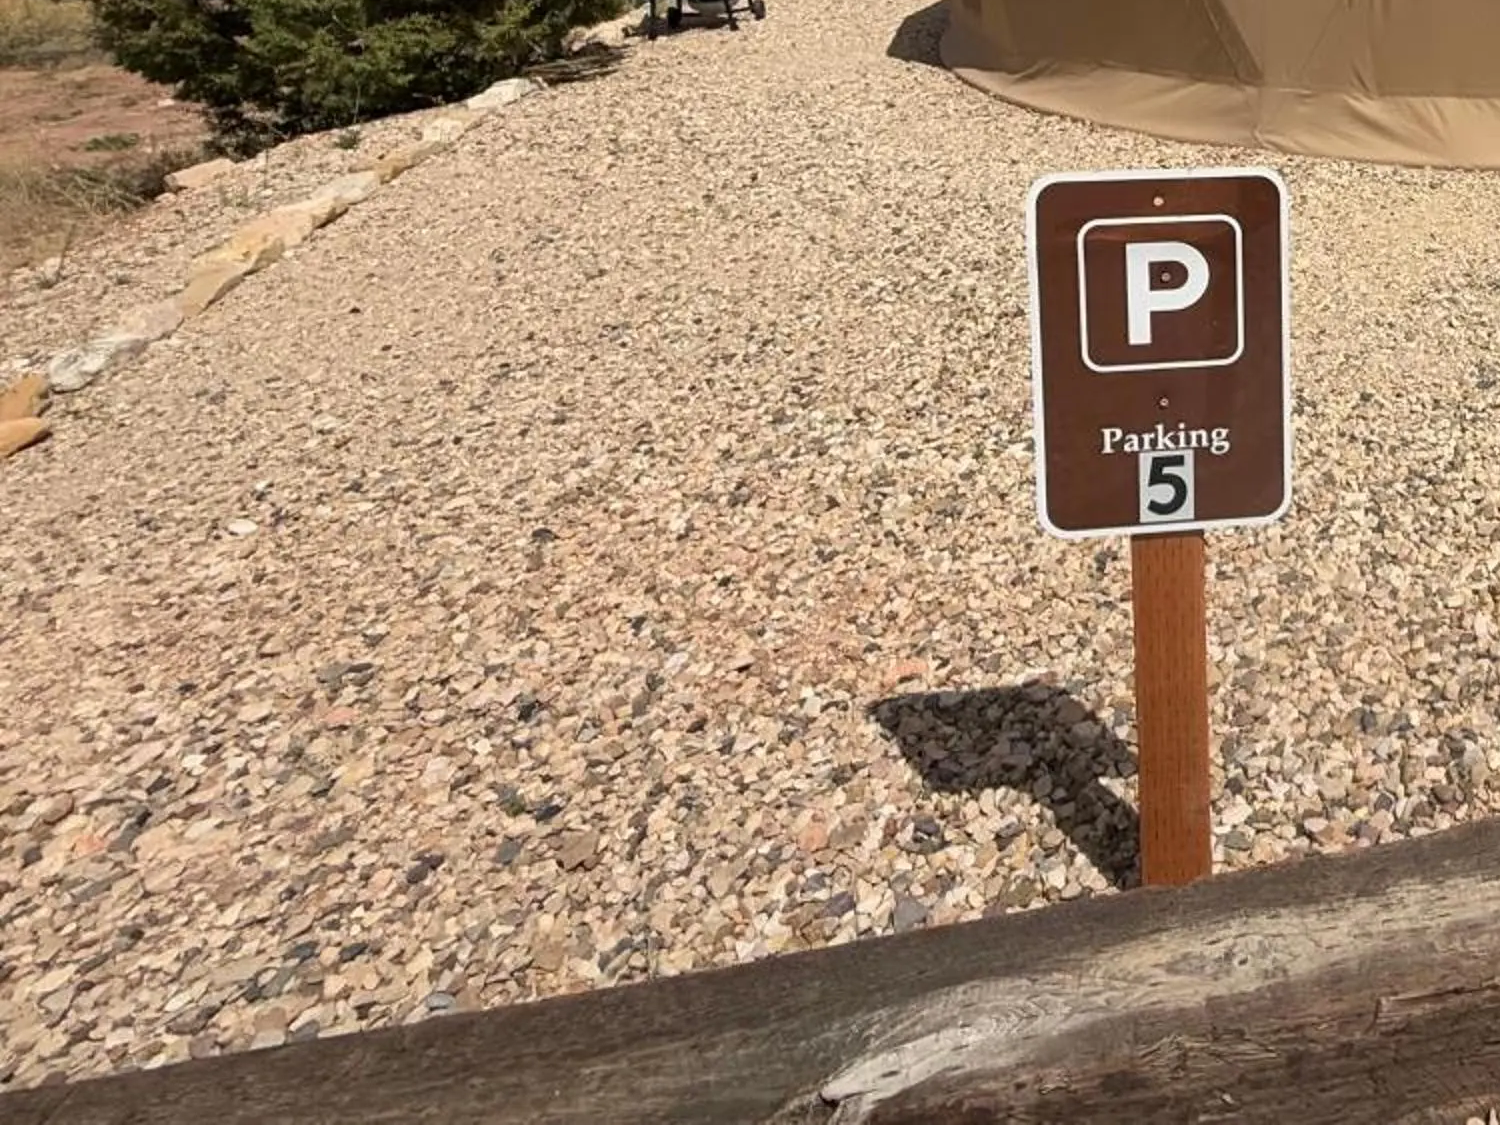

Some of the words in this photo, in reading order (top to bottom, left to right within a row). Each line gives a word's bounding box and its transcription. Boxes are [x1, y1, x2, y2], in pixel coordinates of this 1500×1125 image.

[1125, 240, 1210, 345] P
[1100, 422, 1231, 456] Parking
[1147, 454, 1187, 516] 5
